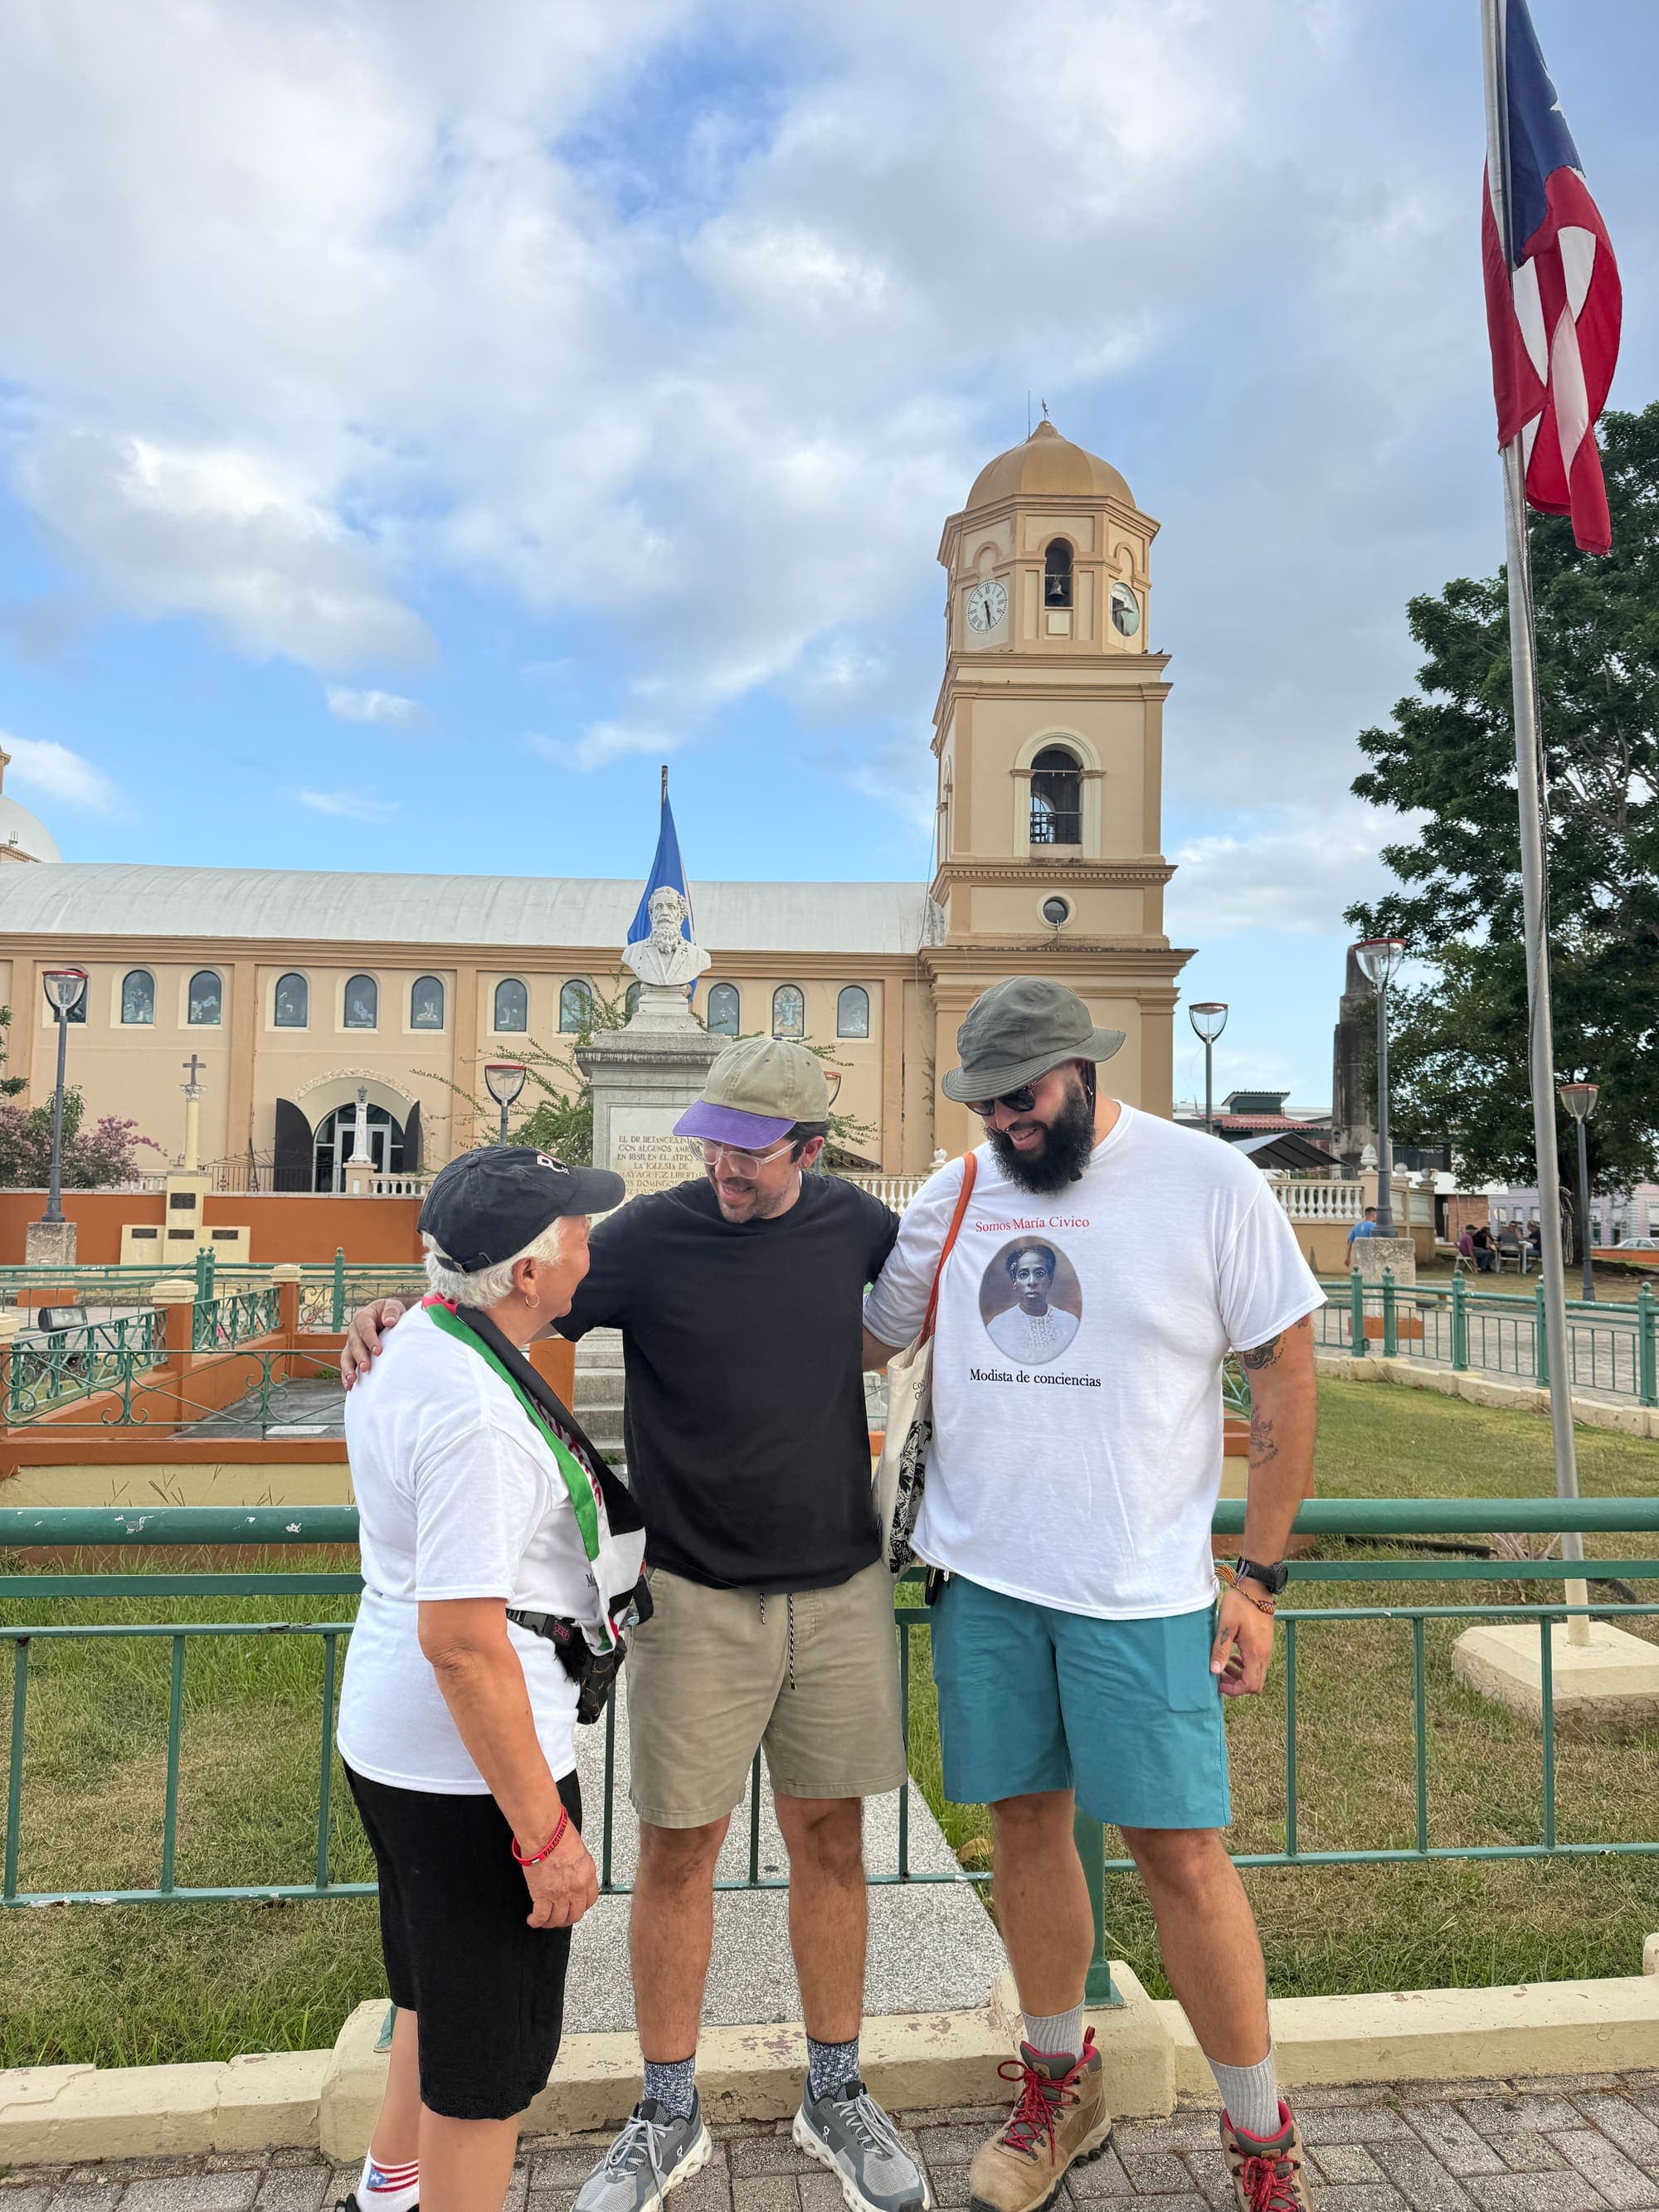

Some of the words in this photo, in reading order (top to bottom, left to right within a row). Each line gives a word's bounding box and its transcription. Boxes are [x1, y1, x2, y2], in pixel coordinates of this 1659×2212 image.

[975, 1222, 1011, 1232] Somos
[1012, 1217, 1045, 1230] María
[970, 1369, 1013, 1382] Modista
[1016, 1370, 1030, 1383] de
[1034, 1373, 1102, 1387] conciencias
